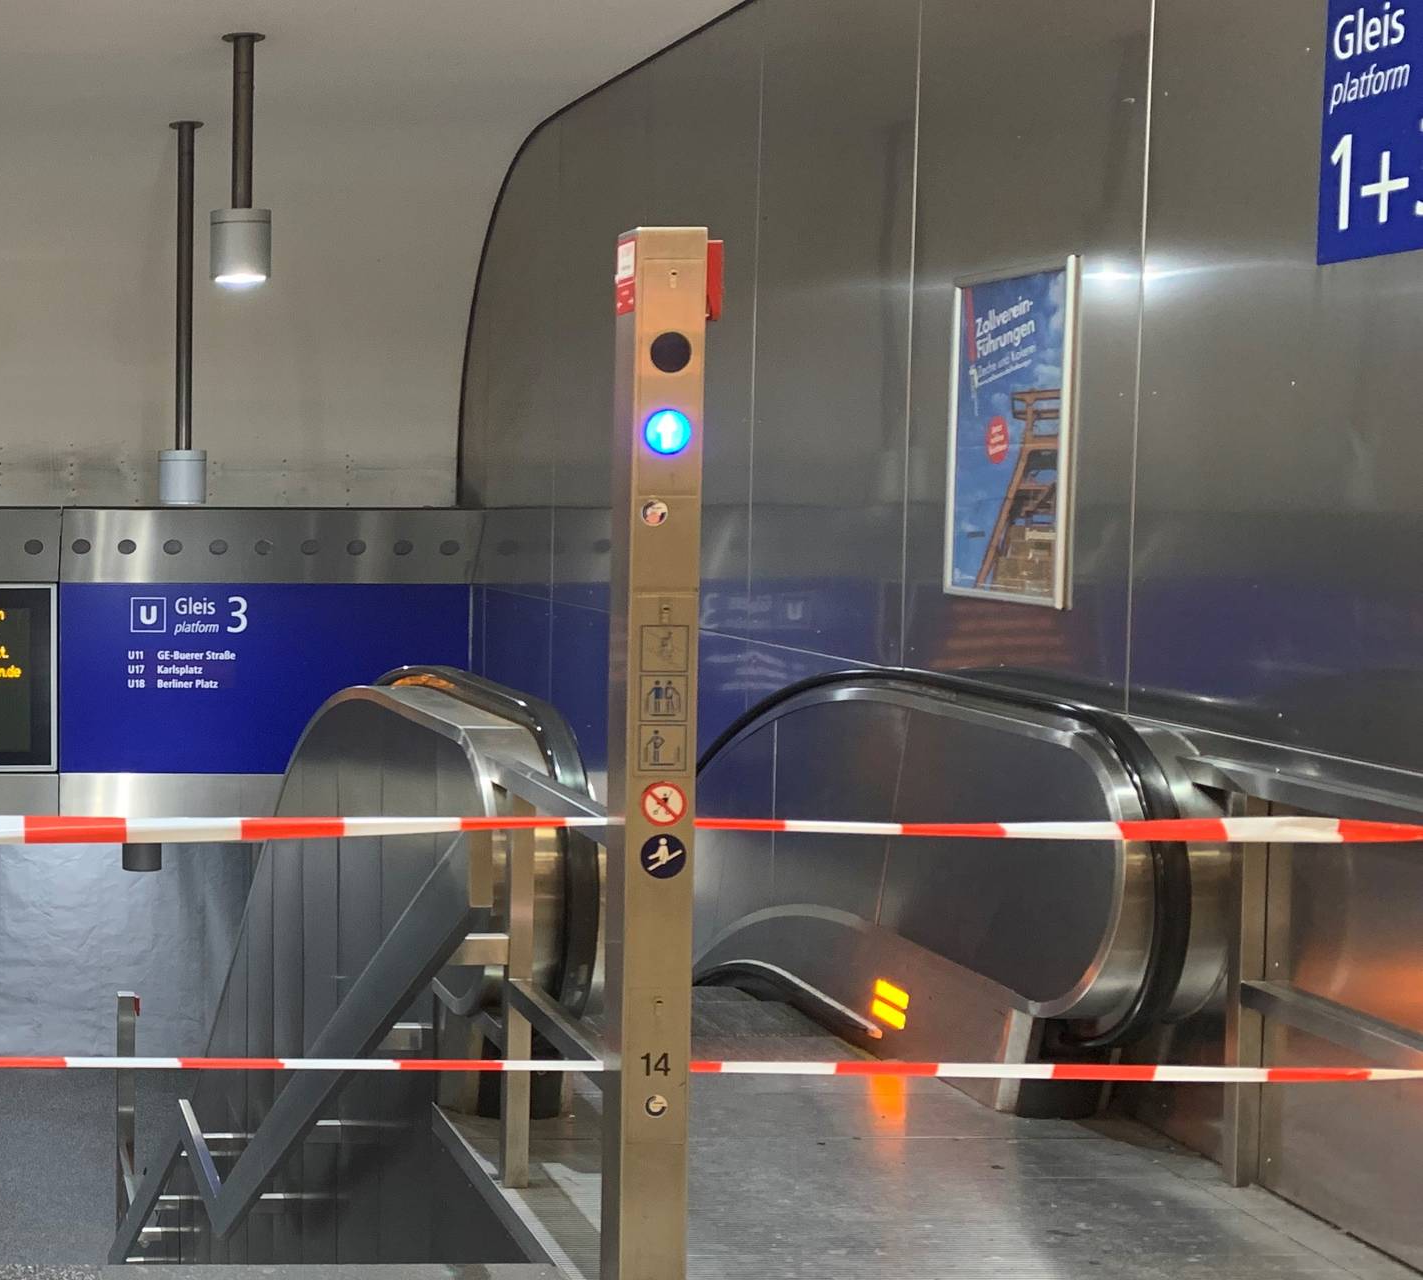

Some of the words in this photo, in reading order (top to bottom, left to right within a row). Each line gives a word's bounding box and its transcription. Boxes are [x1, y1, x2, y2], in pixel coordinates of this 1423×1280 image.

[1333, 1, 1405, 60] Gleis
[1329, 64, 1410, 114] platform
[1331, 118, 1423, 231] 1+
[976, 295, 1034, 338] Zollverein-
[976, 320, 1036, 358] Führungen
[140, 606, 158, 625] U
[174, 620, 220, 636] platform
[175, 597, 216, 615] Gleis
[227, 596, 248, 634] 3
[128, 651, 144, 660] U11
[157, 650, 204, 660] GE-Buerer
[206, 650, 236, 660] Straße
[128, 665, 145, 674] U17
[157, 664, 203, 677] Karlsplatz
[128, 679, 145, 688] U18
[157, 679, 193, 688] Berliner
[195, 679, 218, 688] Platz
[641, 1052, 671, 1076] 14
